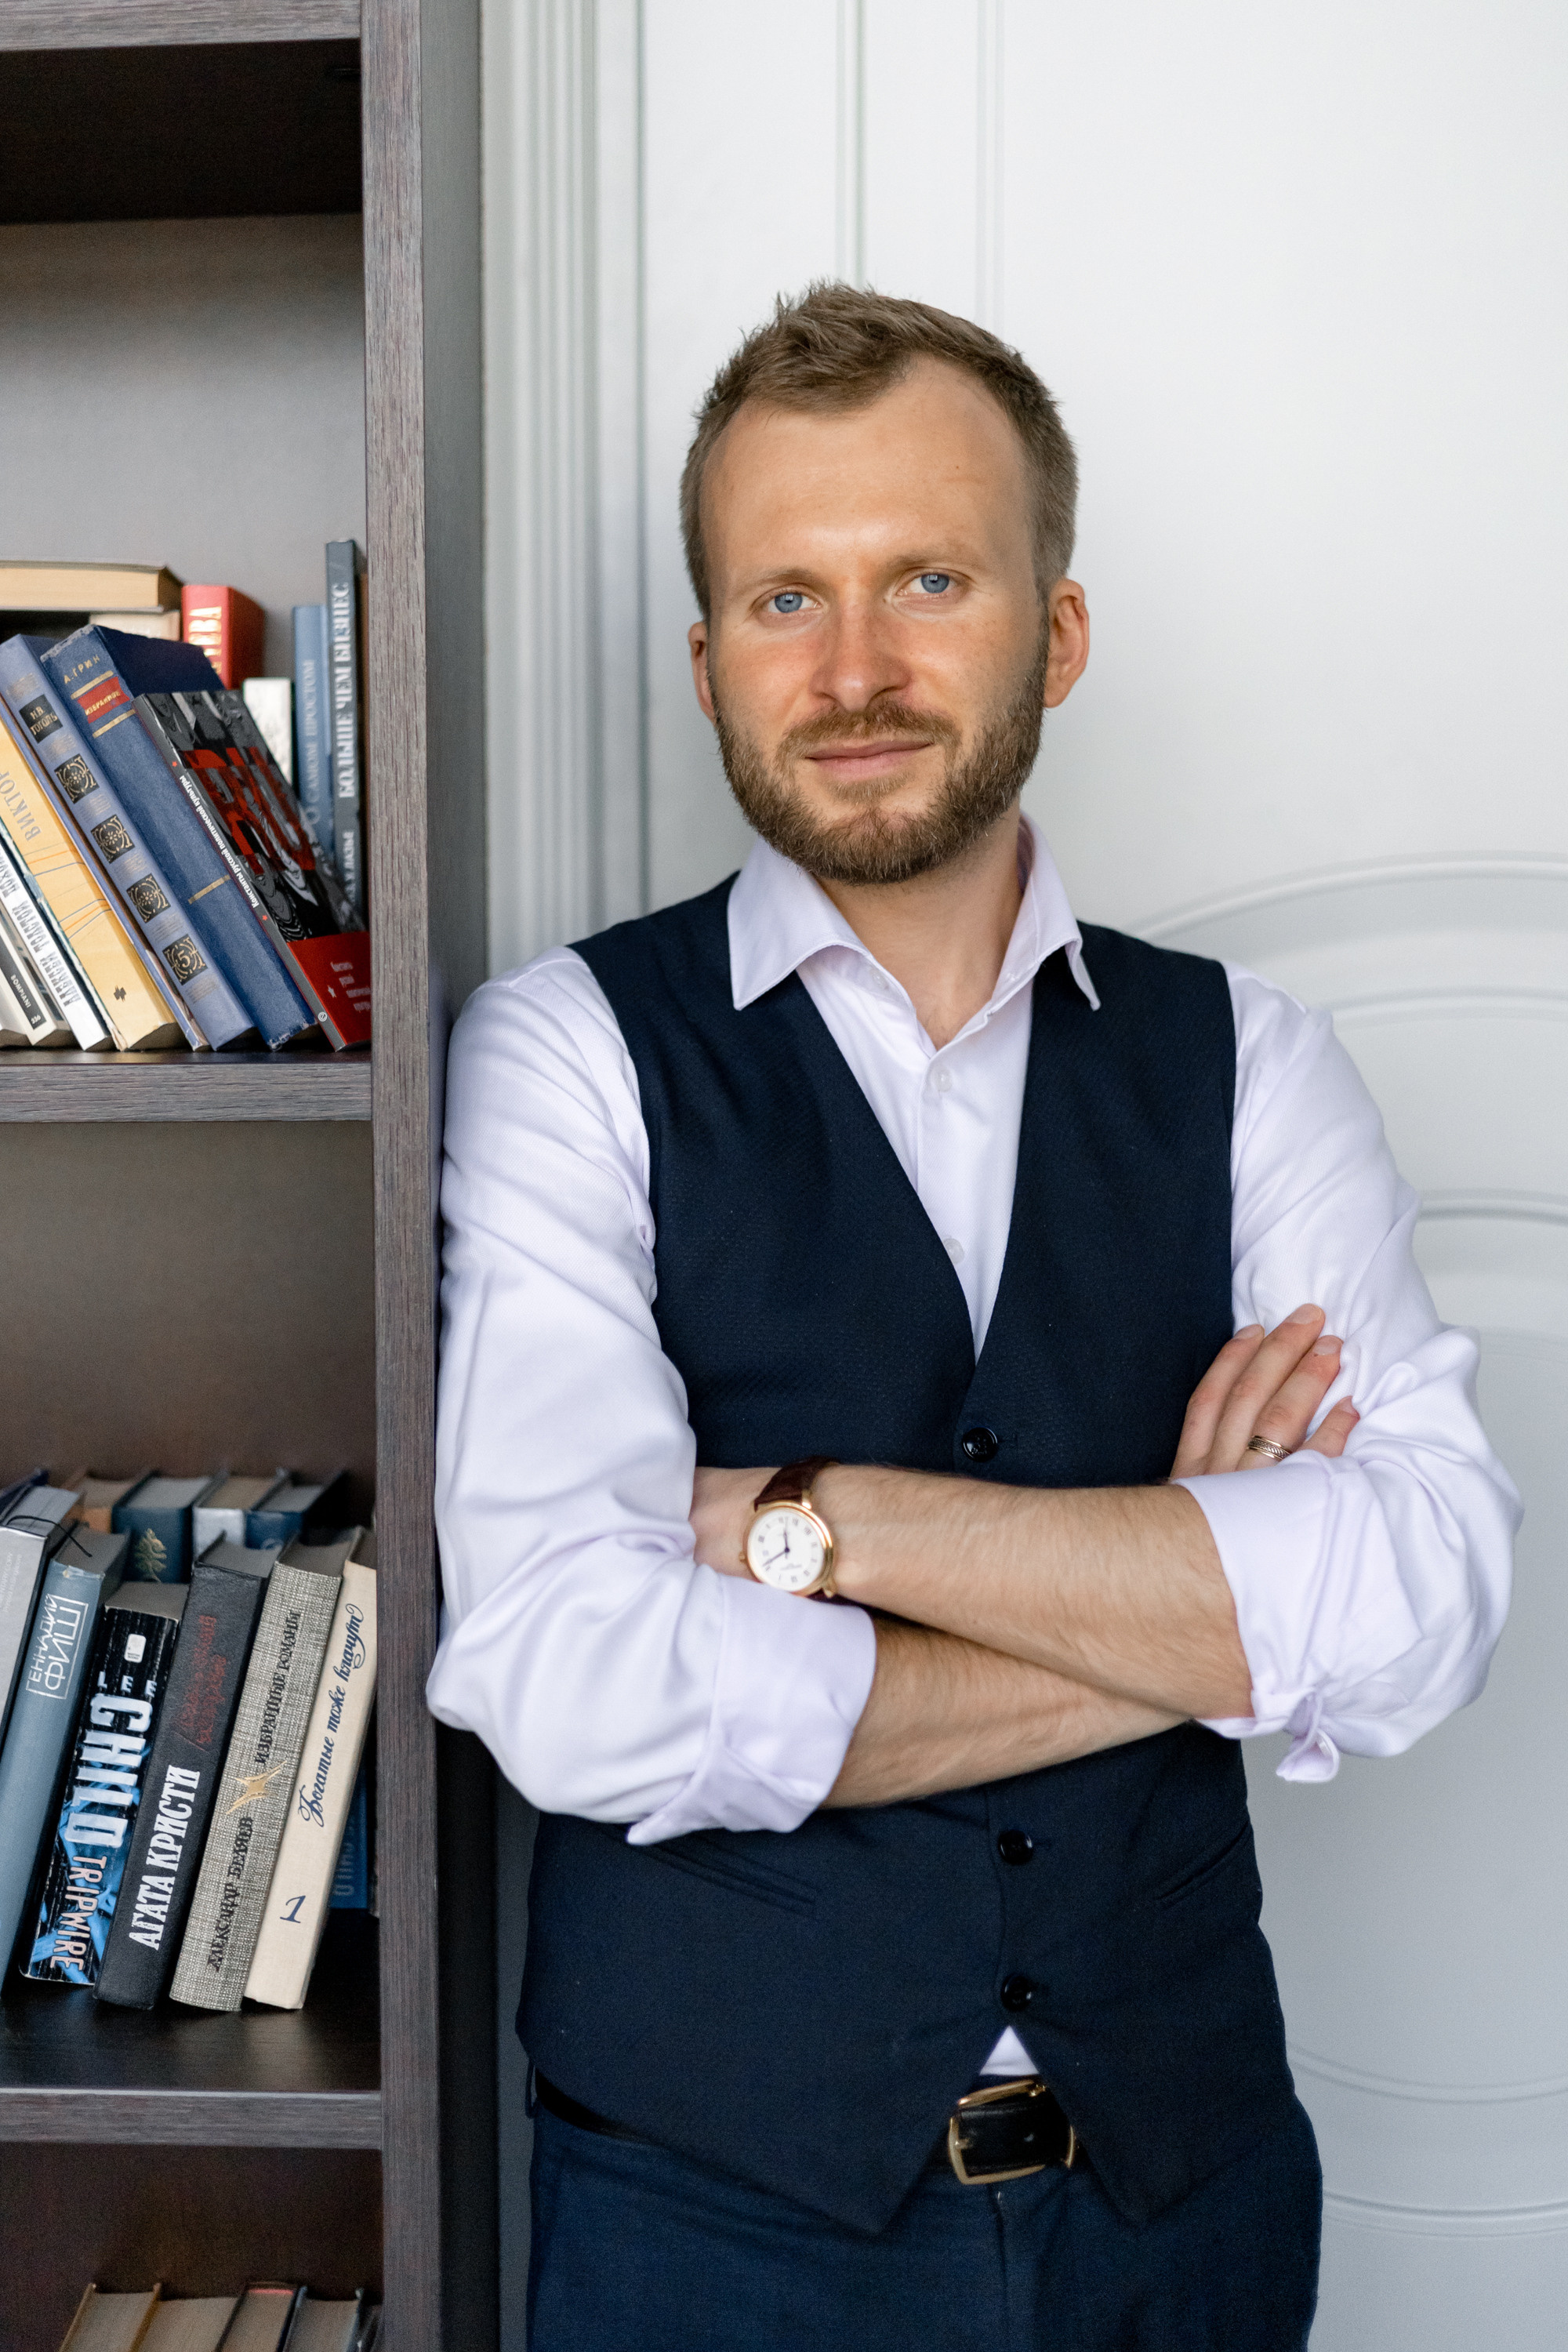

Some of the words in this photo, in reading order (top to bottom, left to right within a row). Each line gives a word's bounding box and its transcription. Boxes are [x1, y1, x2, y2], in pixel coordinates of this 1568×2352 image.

[331, 582, 351, 662] БИЗНЕС
[85, 690, 121, 716] ИЗБРАННОЕ
[333, 666, 354, 710] ЧЕМ
[30, 712, 58, 735] ГОГОЛЬ
[336, 713, 355, 798] БОЛЬШЕ
[179, 775, 201, 809] культуры
[195, 804, 226, 851] политической
[221, 847, 241, 876] русской
[237, 872, 260, 909] Константы
[12, 900, 50, 954] ТОЛСТОЙ
[40, 950, 82, 1008] АЛЕКСЕЙ
[177, 949, 191, 968] 5
[10, 974, 31, 1008] BOMPIANI
[26, 1593, 57, 1690] ГЕННАДИЙ
[44, 1606, 81, 1690] ФИШ
[333, 1602, 366, 1682] плачут
[97, 1671, 157, 1698] LEE
[254, 1671, 285, 1765] ИЗБРАННЫЕ
[277, 1610, 301, 1671] РОМАНЫ
[327, 1685, 346, 1733] тоже
[64, 1693, 153, 1849] CHILD
[298, 1736, 335, 1828] Богатые
[145, 1764, 201, 1872] КРИСТИ
[49, 1856, 107, 1971] TRIPWIRE
[129, 1875, 176, 1951] АГАТА
[207, 1881, 240, 1973] АЛЕКСАНДР
[227, 1816, 253, 1879] БЕЛЯЕВ
[279, 1895, 307, 1924] 1
